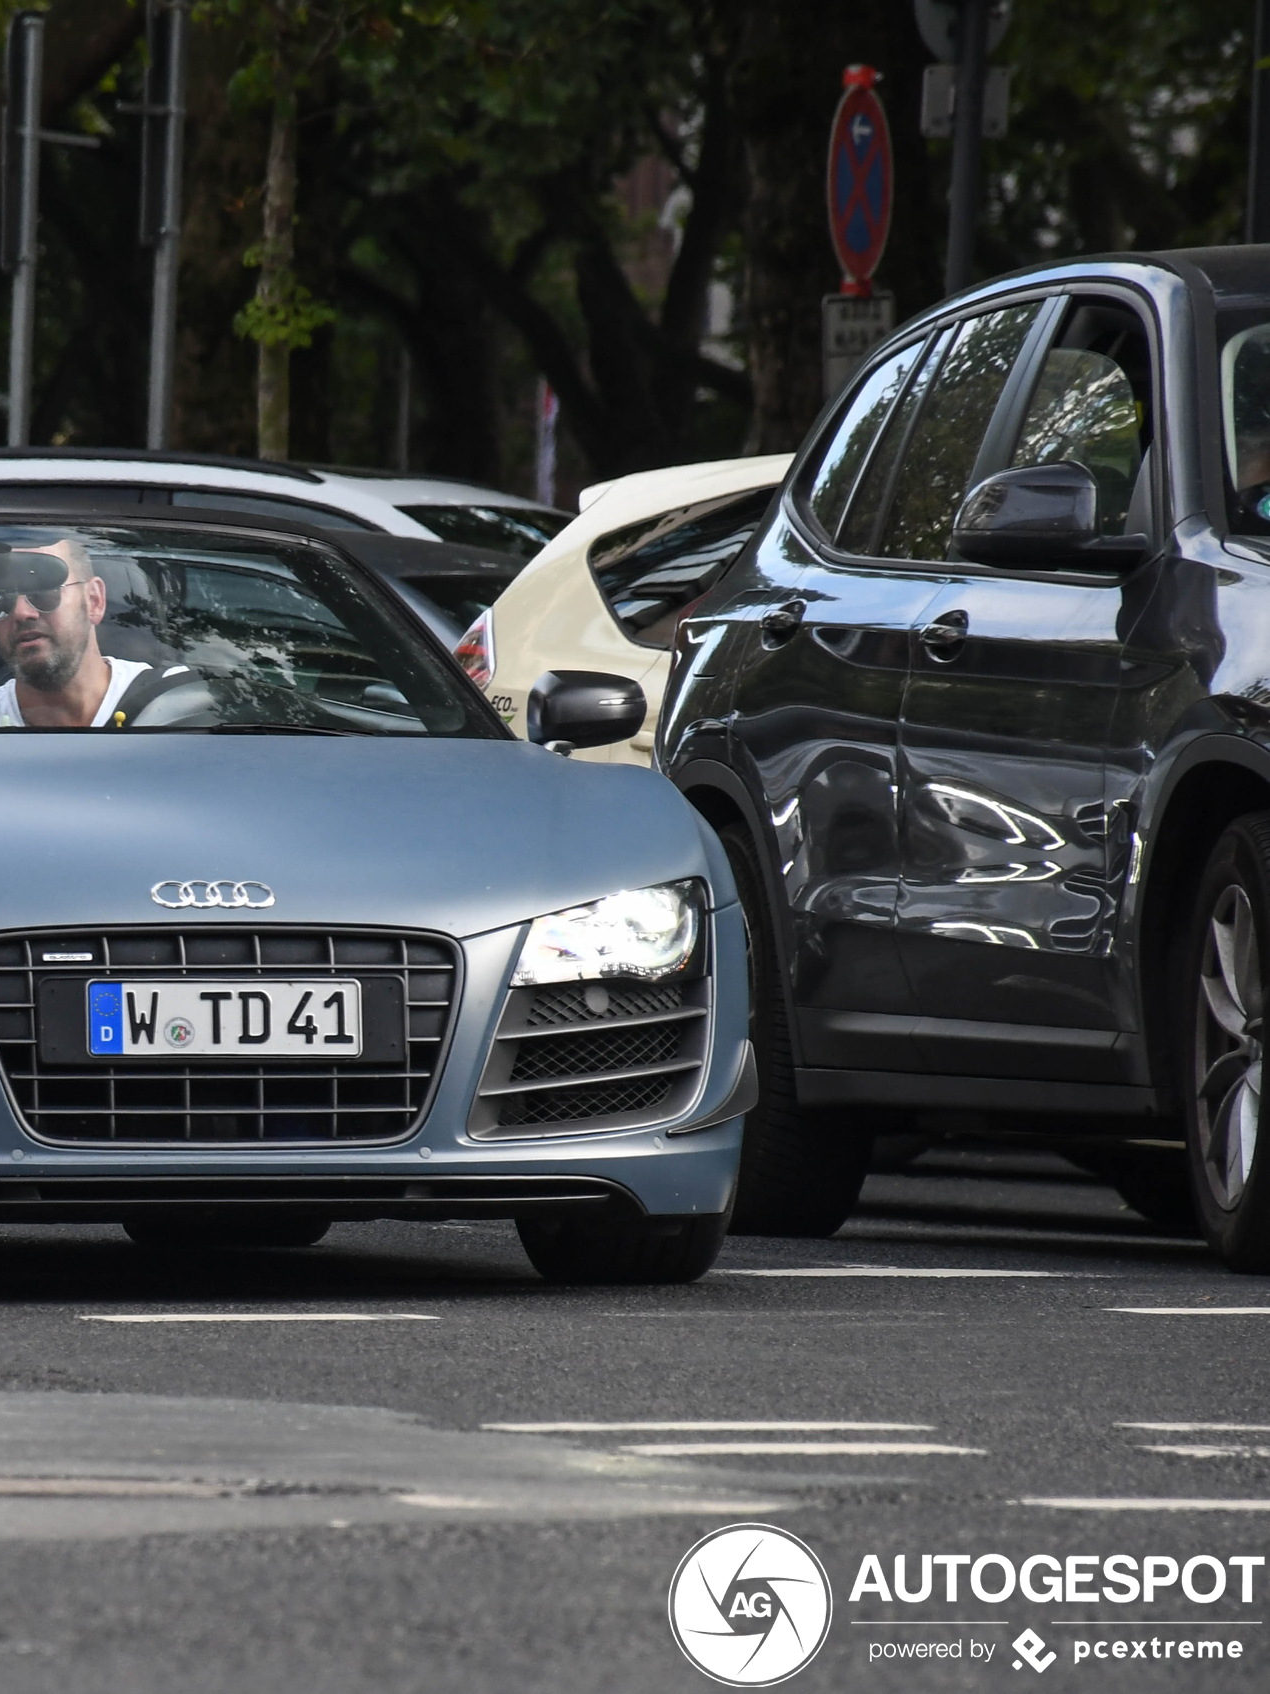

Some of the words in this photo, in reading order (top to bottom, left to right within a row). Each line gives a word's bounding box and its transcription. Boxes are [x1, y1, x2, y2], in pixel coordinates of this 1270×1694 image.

[101, 1026, 113, 1042] D
[126, 991, 159, 1045] W
[199, 991, 272, 1045] TD
[287, 991, 354, 1045] 41
